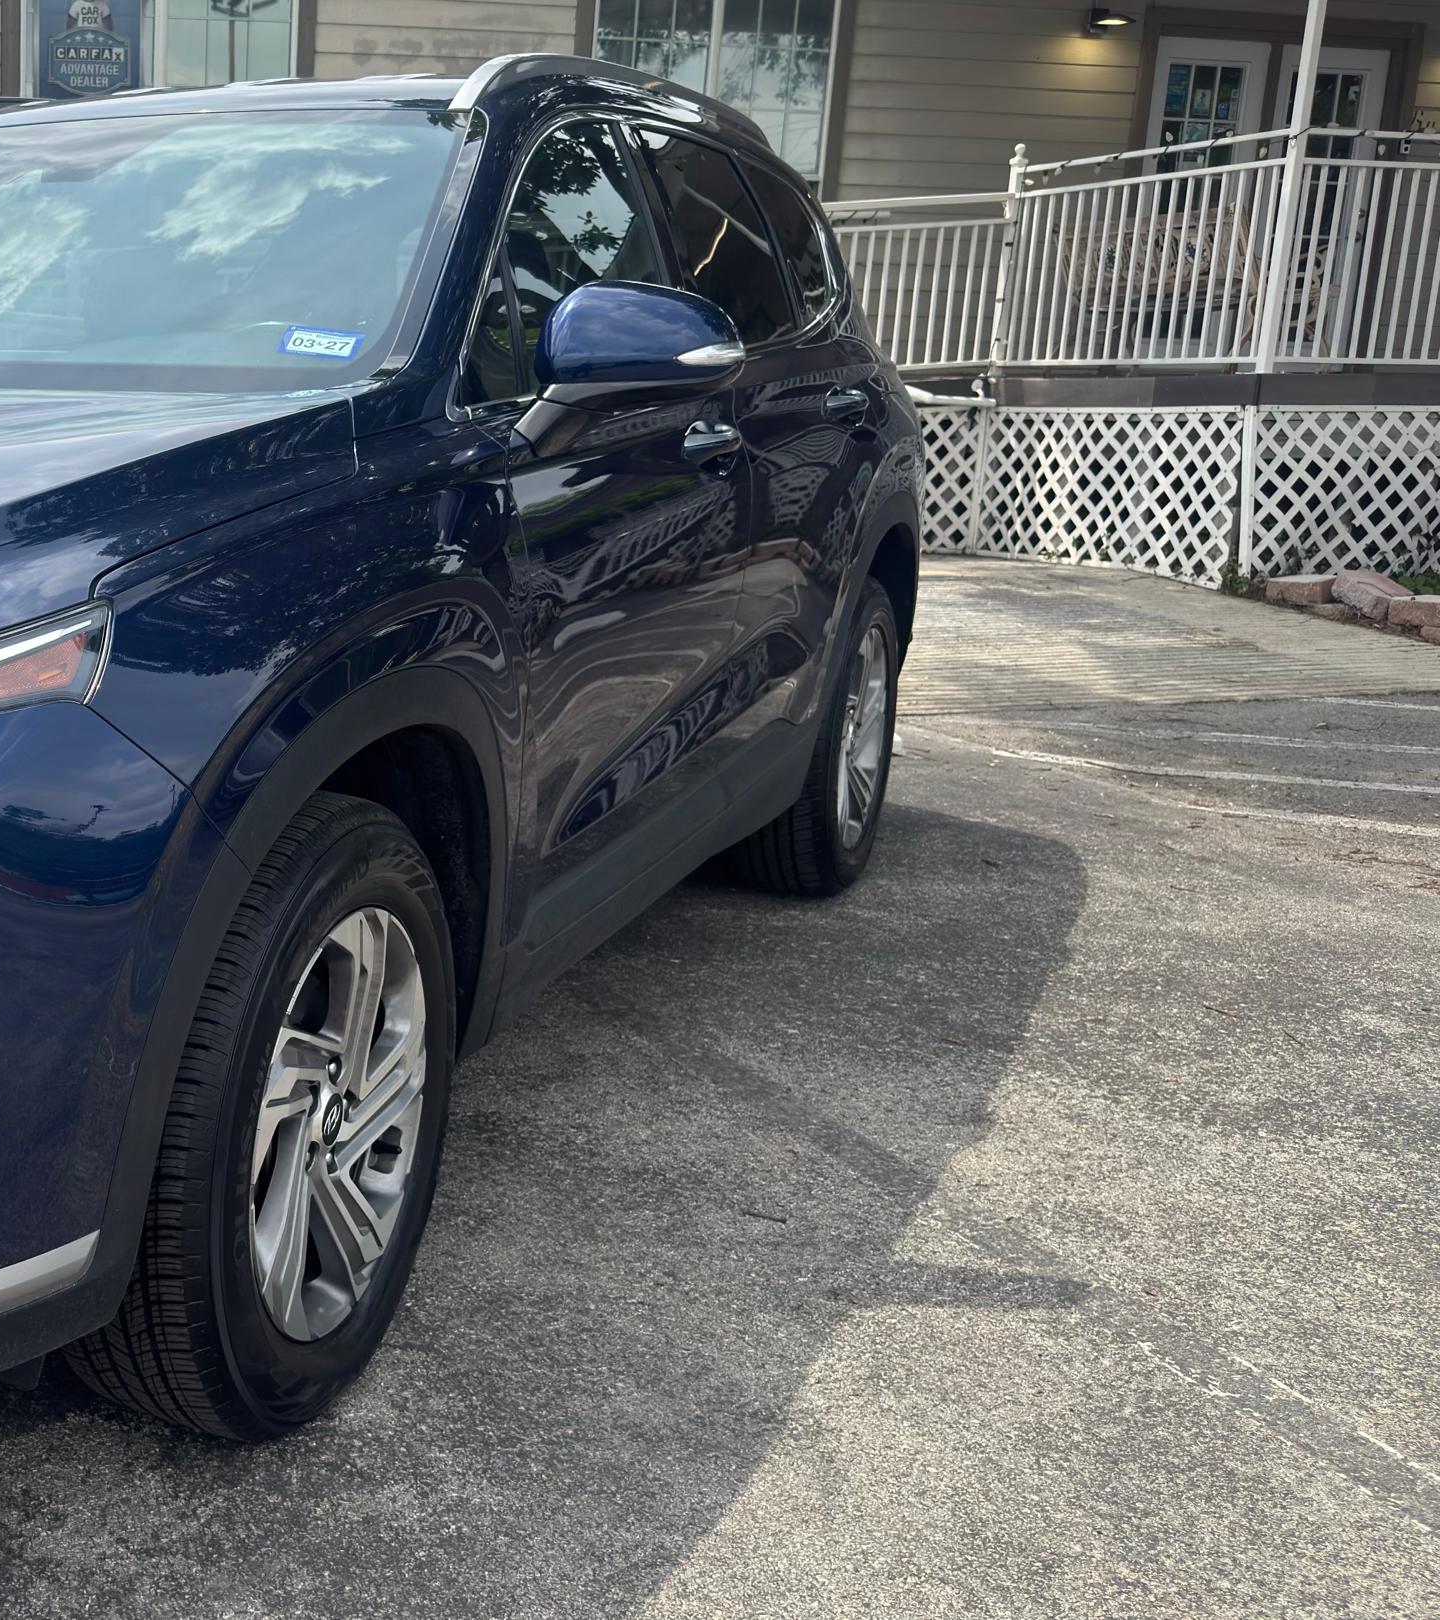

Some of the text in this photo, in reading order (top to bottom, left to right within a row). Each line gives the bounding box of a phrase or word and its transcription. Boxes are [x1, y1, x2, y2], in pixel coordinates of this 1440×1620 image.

[81, 7, 99, 16] CAR
[82, 17, 99, 25] FOX
[56, 47, 123, 62] CARFAX
[60, 63, 119, 75] ADVANTAGE
[70, 76, 109, 88] DEALER
